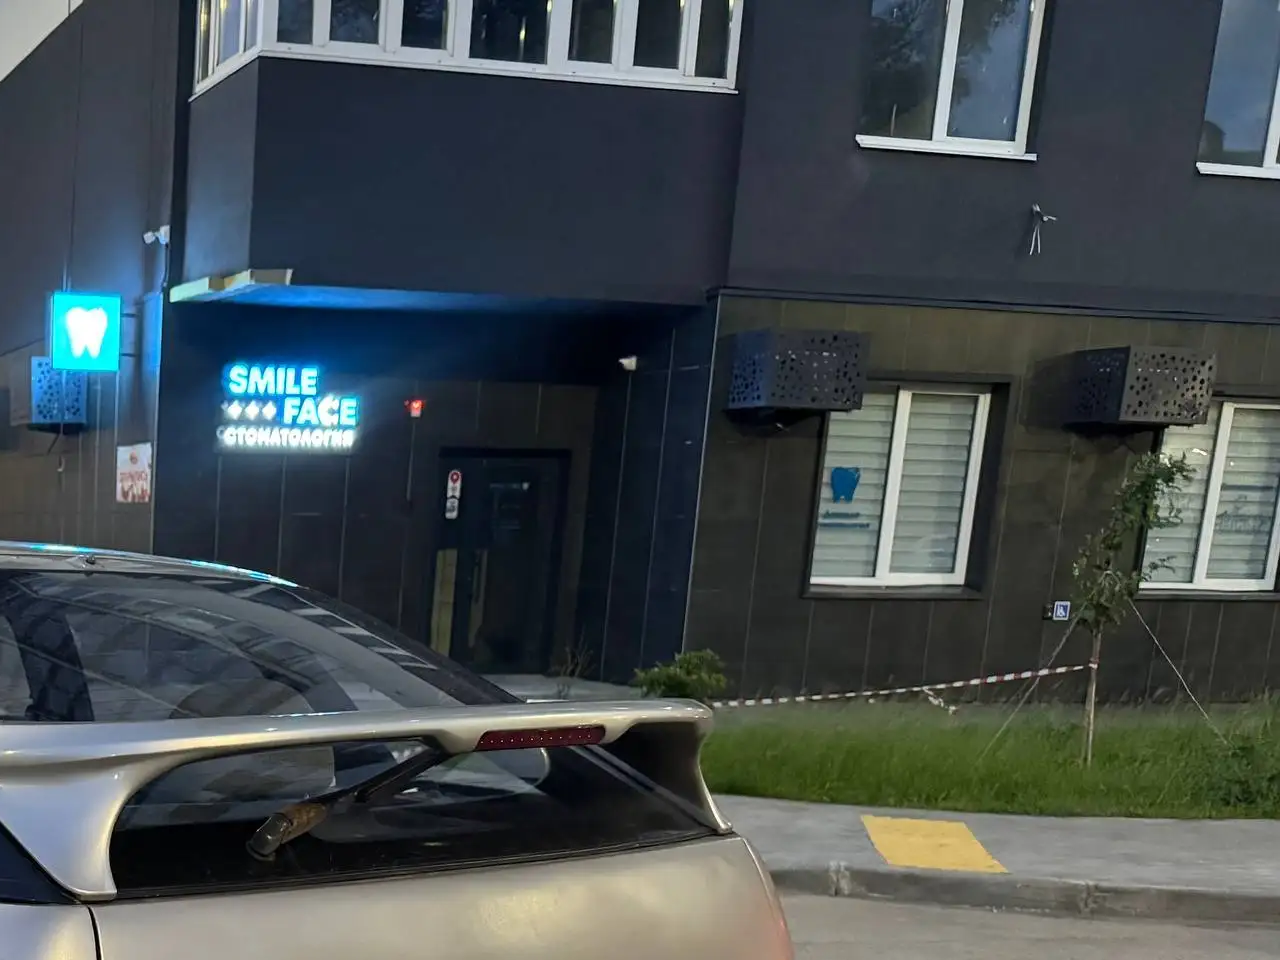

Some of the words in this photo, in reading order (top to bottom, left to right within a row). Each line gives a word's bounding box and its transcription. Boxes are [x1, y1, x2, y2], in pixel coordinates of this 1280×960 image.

[228, 364, 318, 396] SMILE
[283, 394, 357, 426] FACE
[223, 427, 354, 447] СТОМАТОЛОГИЯ
